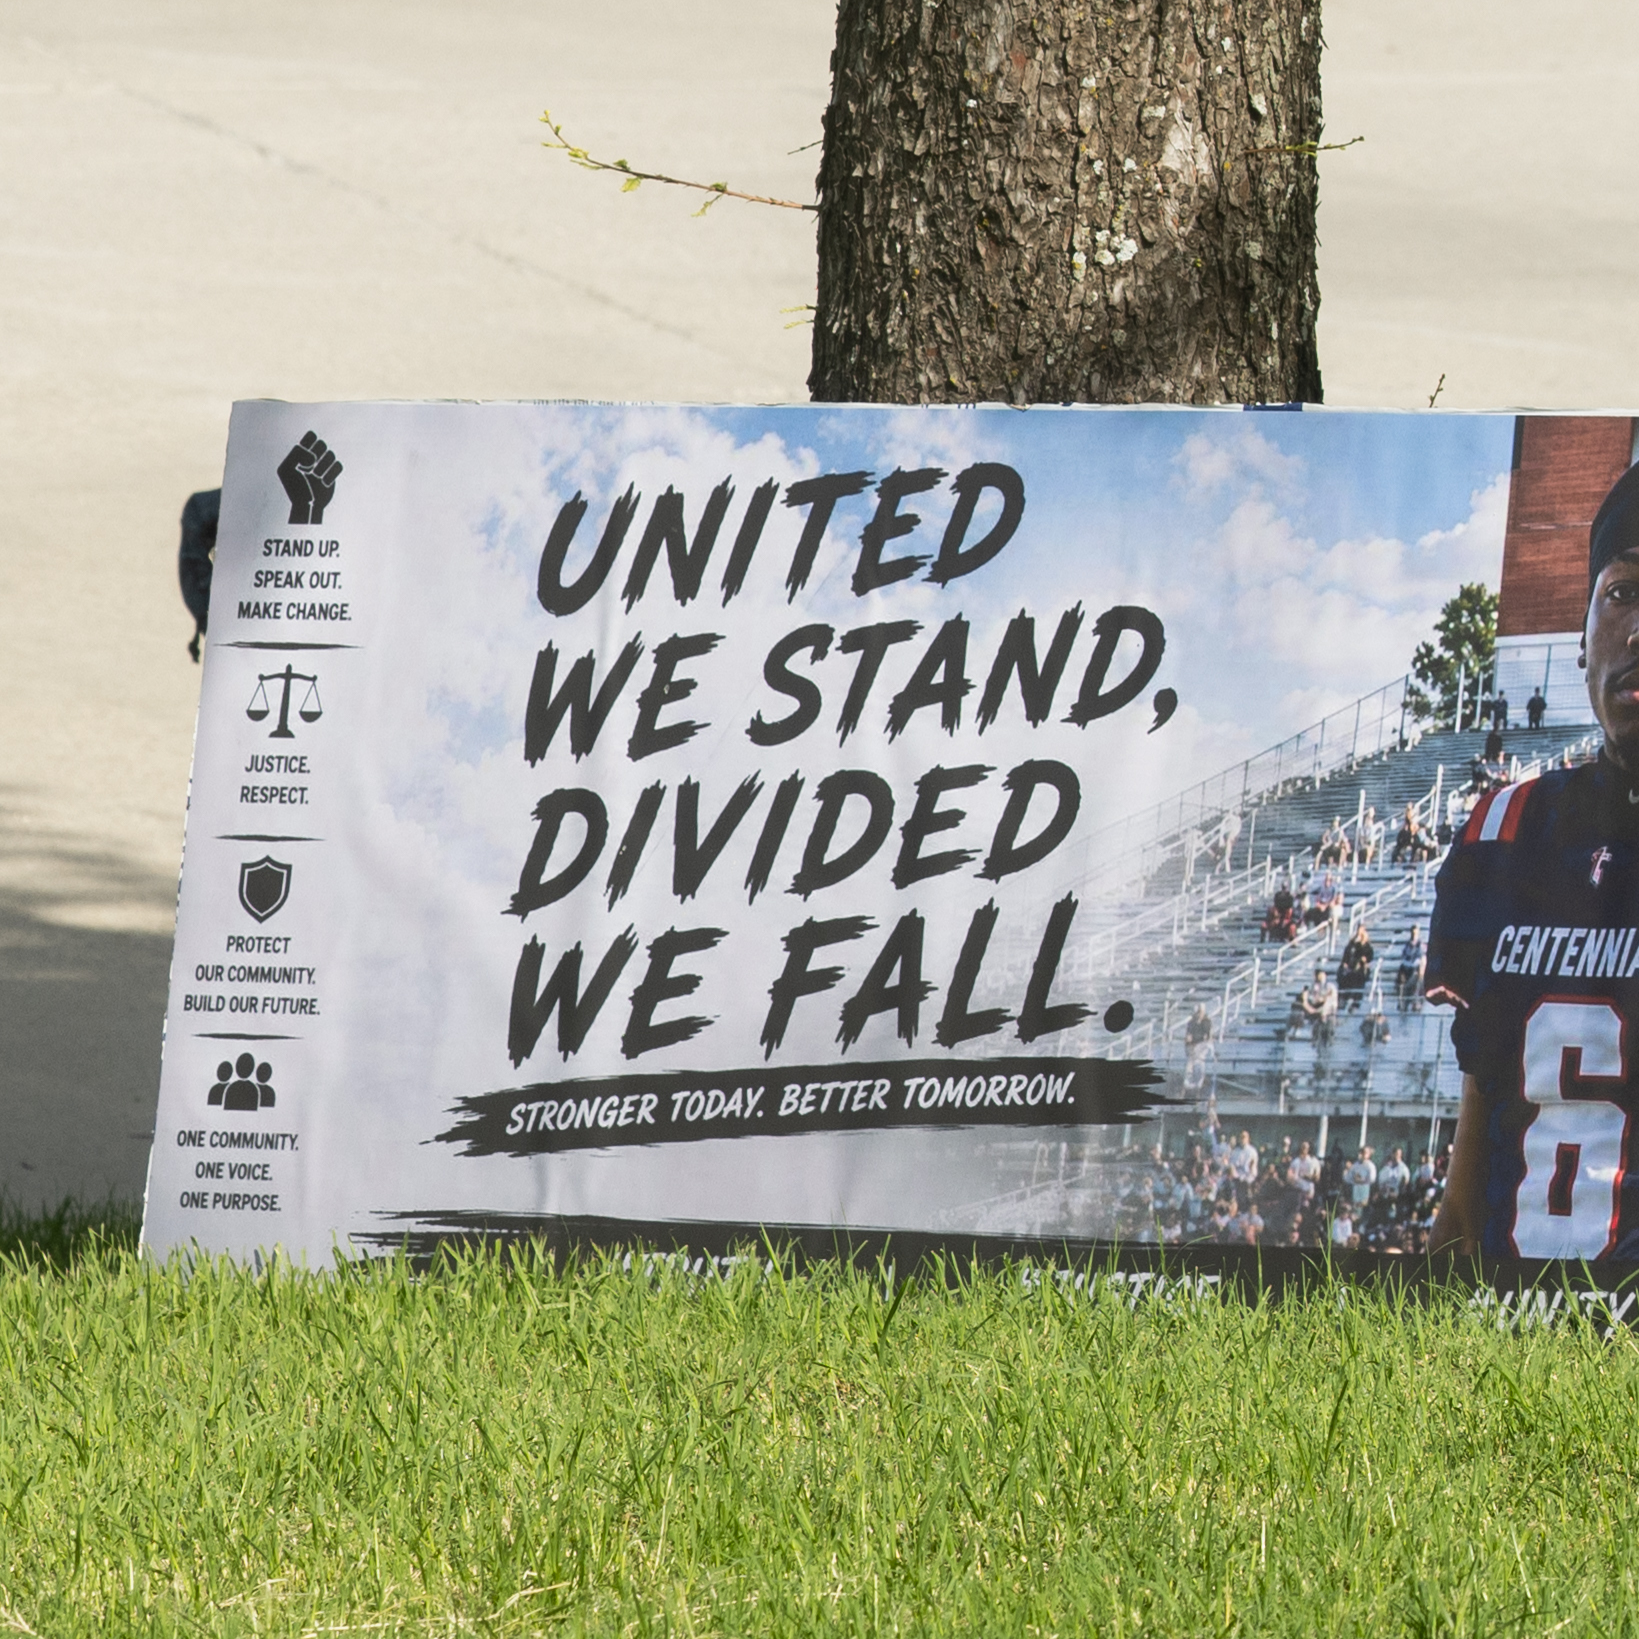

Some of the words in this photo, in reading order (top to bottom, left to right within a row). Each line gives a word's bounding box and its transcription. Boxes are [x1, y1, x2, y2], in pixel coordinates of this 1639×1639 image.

[263, 539, 313, 557] STAND
[318, 540, 340, 557] UP.
[537, 461, 1026, 616] UNITED
[254, 571, 304, 588] SPEAK
[309, 572, 342, 589] OUT.
[237, 601, 282, 619] MAKE
[286, 603, 352, 621] CHANGE.
[525, 630, 725, 768] WE
[749, 599, 1178, 748] STAND,
[245, 755, 310, 773] JUSTICE.
[240, 786, 308, 804] RESPECT.
[501, 759, 1082, 923] DIVIDED
[226, 936, 291, 953] PROTECT
[195, 964, 224, 982] OUR
[228, 966, 316, 984] COMMUNITY.
[507, 924, 728, 1068] WE
[759, 890, 1134, 1061] FALL.
[184, 995, 225, 1012] BUILD
[229, 996, 258, 1013] OUR
[261, 997, 320, 1015] FUTURE.
[505, 1091, 658, 1135] STRONGER
[670, 1085, 764, 1122] TODAY.
[778, 1078, 891, 1116] BETTER
[902, 1071, 1076, 1109] TOMORROW.
[1508, 994, 1629, 1260] 6
[177, 1130, 205, 1147] ONE
[210, 1132, 299, 1151] COMMUNITY.
[195, 1162, 224, 1179] ONE
[229, 1163, 272, 1181] VOICE.
[180, 1192, 209, 1209] ONE
[212, 1192, 281, 1211] PURPOSE.
